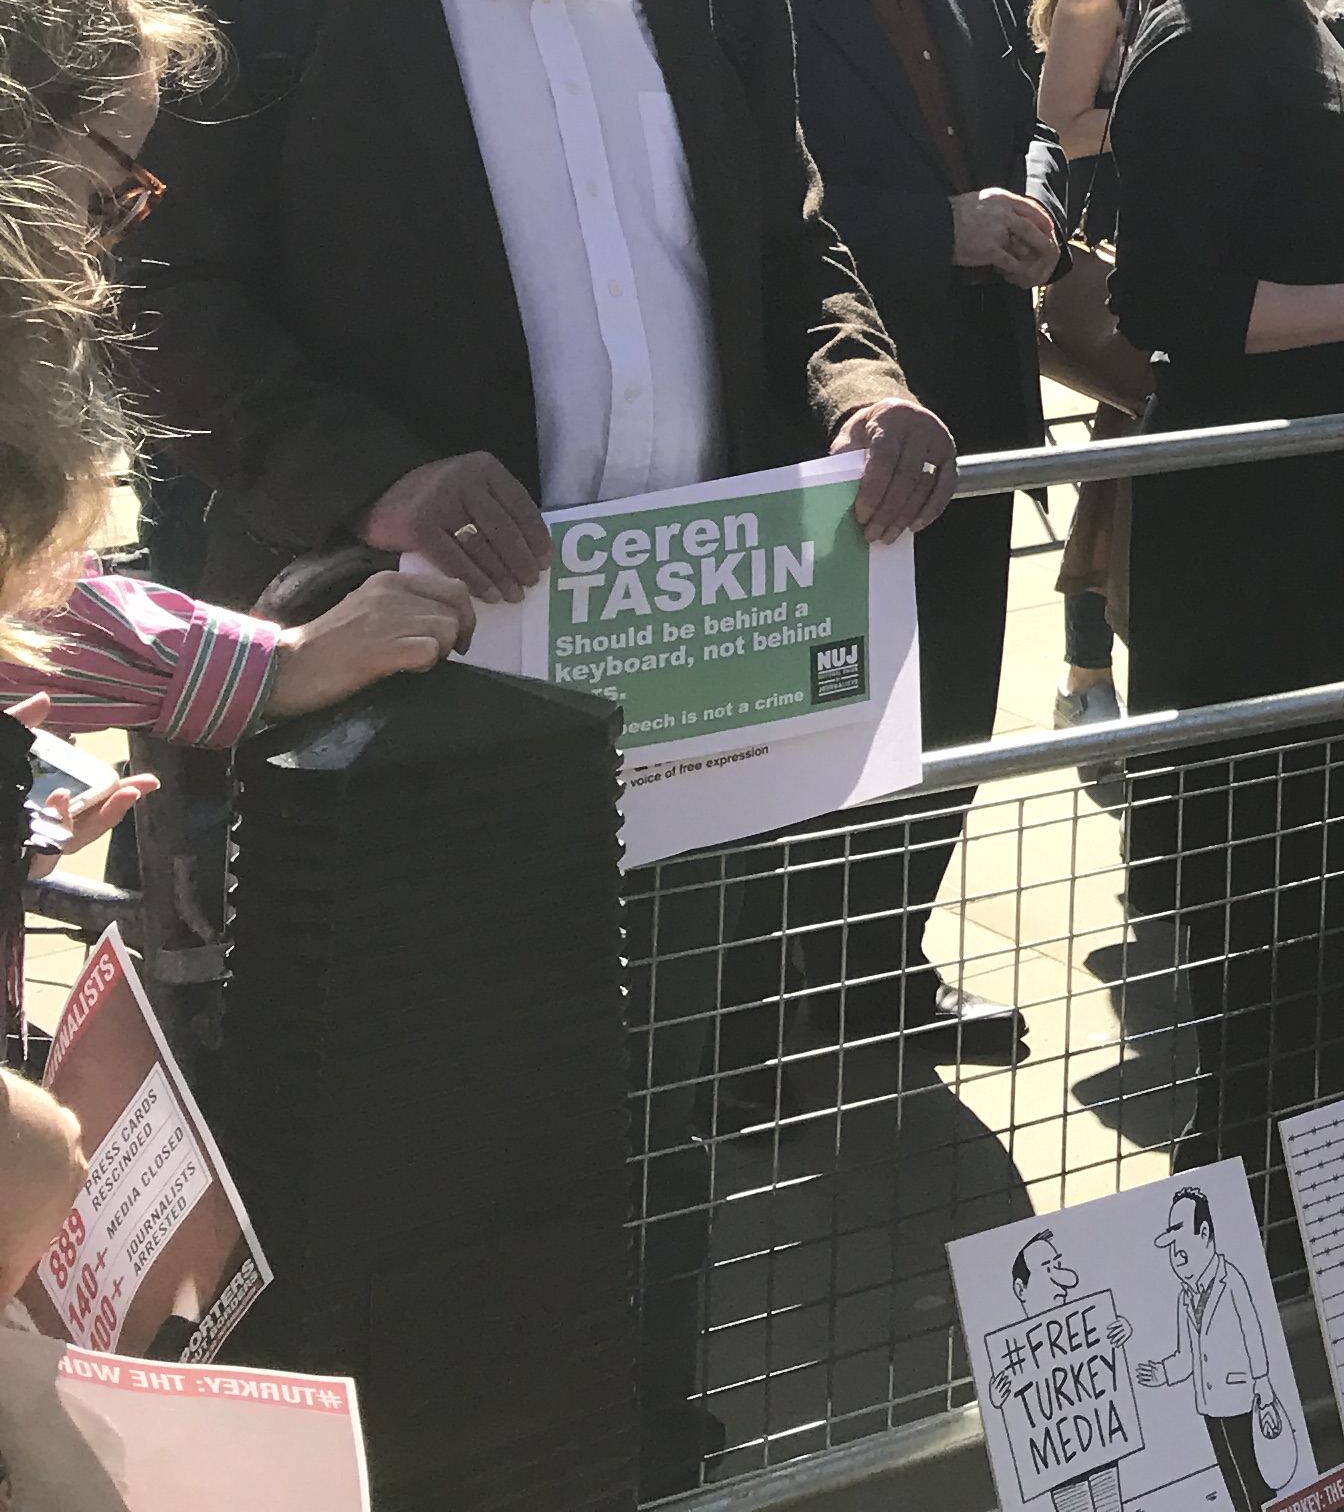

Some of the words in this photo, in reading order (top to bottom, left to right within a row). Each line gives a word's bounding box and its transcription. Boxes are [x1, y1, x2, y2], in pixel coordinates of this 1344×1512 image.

[558, 541, 815, 624] TASKIN
[561, 512, 759, 573] Ceren
[555, 645, 695, 684] keyboard,
[704, 636, 746, 661] not
[753, 617, 832, 651] behind
[556, 625, 653, 656] Should
[663, 623, 696, 643] be
[704, 602, 788, 635] behind
[795, 603, 809, 618] a
[817, 644, 858, 671] NUJ
[682, 704, 698, 724] is
[703, 701, 734, 721] not
[738, 699, 750, 714] a
[754, 689, 804, 711] crime
[630, 772, 662, 788] voice
[664, 766, 676, 778] of
[679, 760, 703, 775] free
[706, 744, 769, 771] expression
[48, 953, 115, 1082] URNALISTS
[85, 1141, 121, 1196] PRESS
[121, 1089, 158, 1142] CARDS
[91, 1122, 153, 1212] RESCINDED
[50, 1208, 86, 1289] 889
[68, 1247, 108, 1333] 140+
[106, 1187, 142, 1240] MEDIA
[140, 1126, 184, 1188] CLOSED
[126, 1160, 196, 1263] JOURNALISTS
[133, 1195, 187, 1277] ARRESTED
[178, 1258, 255, 1363] PORTERS
[1001, 1305, 1101, 1375] #FREE
[1014, 1347, 1118, 1428] TURKEY
[1029, 1400, 1128, 1475] MEDIA
